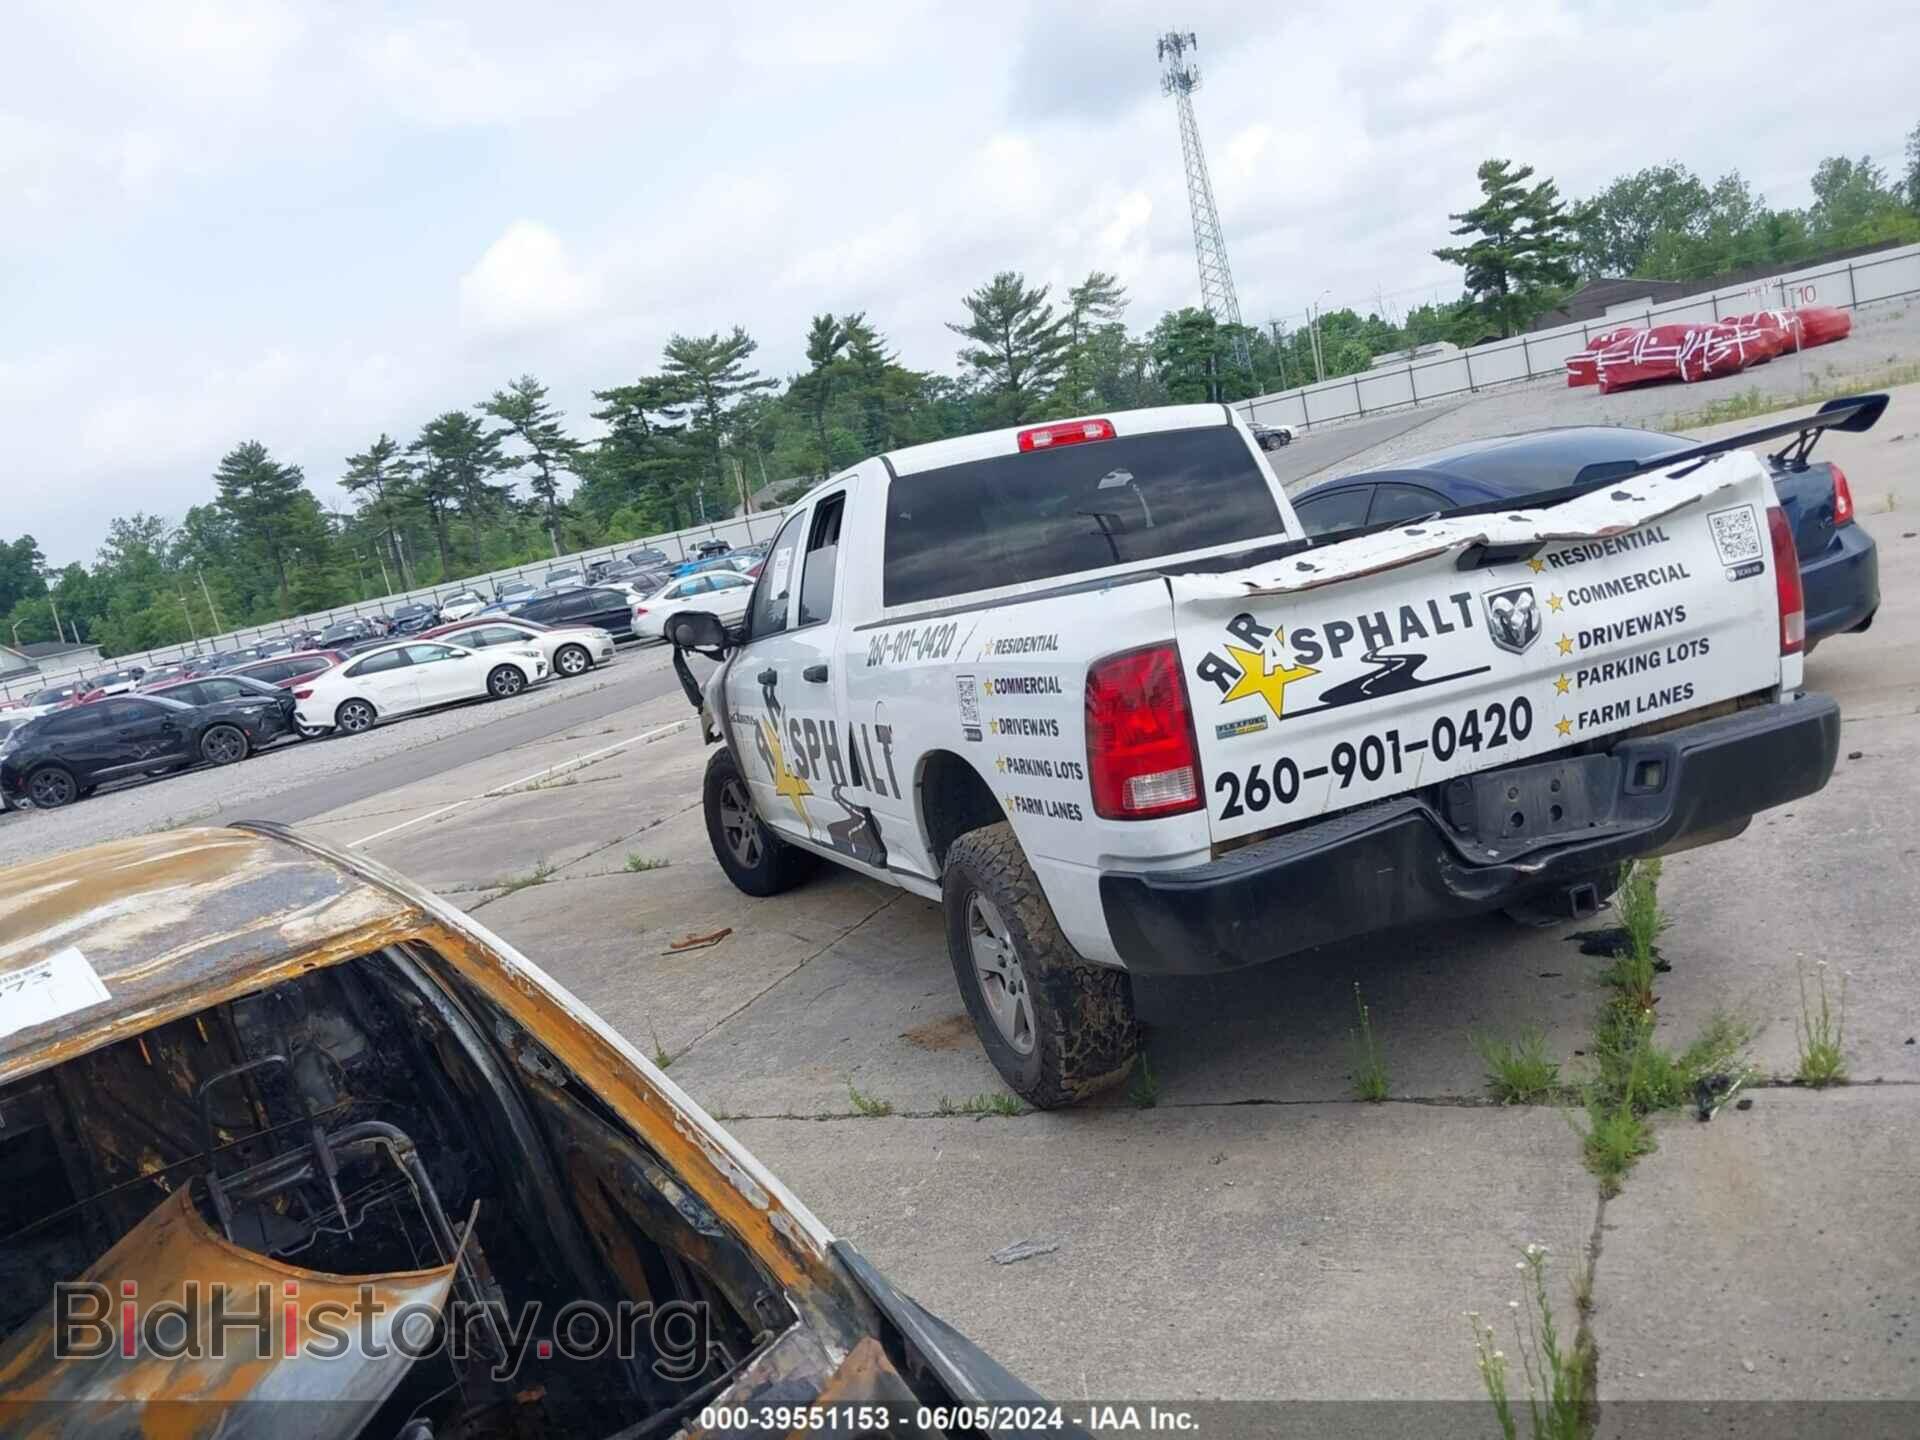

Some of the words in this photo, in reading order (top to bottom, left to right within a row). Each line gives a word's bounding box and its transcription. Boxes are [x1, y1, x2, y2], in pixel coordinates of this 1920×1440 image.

[1547, 526, 1670, 568] RESIDENTIAL
[1567, 562, 1691, 606] COMMERCIAL
[867, 622, 957, 667] 260-901-0420
[994, 634, 1059, 655] RESIDENTIAL
[1578, 605, 1686, 649] DRIVEWAYS
[1576, 651, 1661, 689] PARKING
[1667, 638, 1710, 664] LOTS
[994, 676, 1062, 695] COMMERCIAL
[1578, 700, 1631, 729] FARM
[1637, 682, 1694, 714] LANES
[999, 718, 1060, 737] DRIVEWAYS
[1006, 757, 1053, 777] PARKING
[1054, 761, 1083, 780] LOTS
[1214, 696, 1533, 820] 260-901-0420
[1015, 796, 1044, 816] FARM
[1045, 800, 1083, 821] LANES
